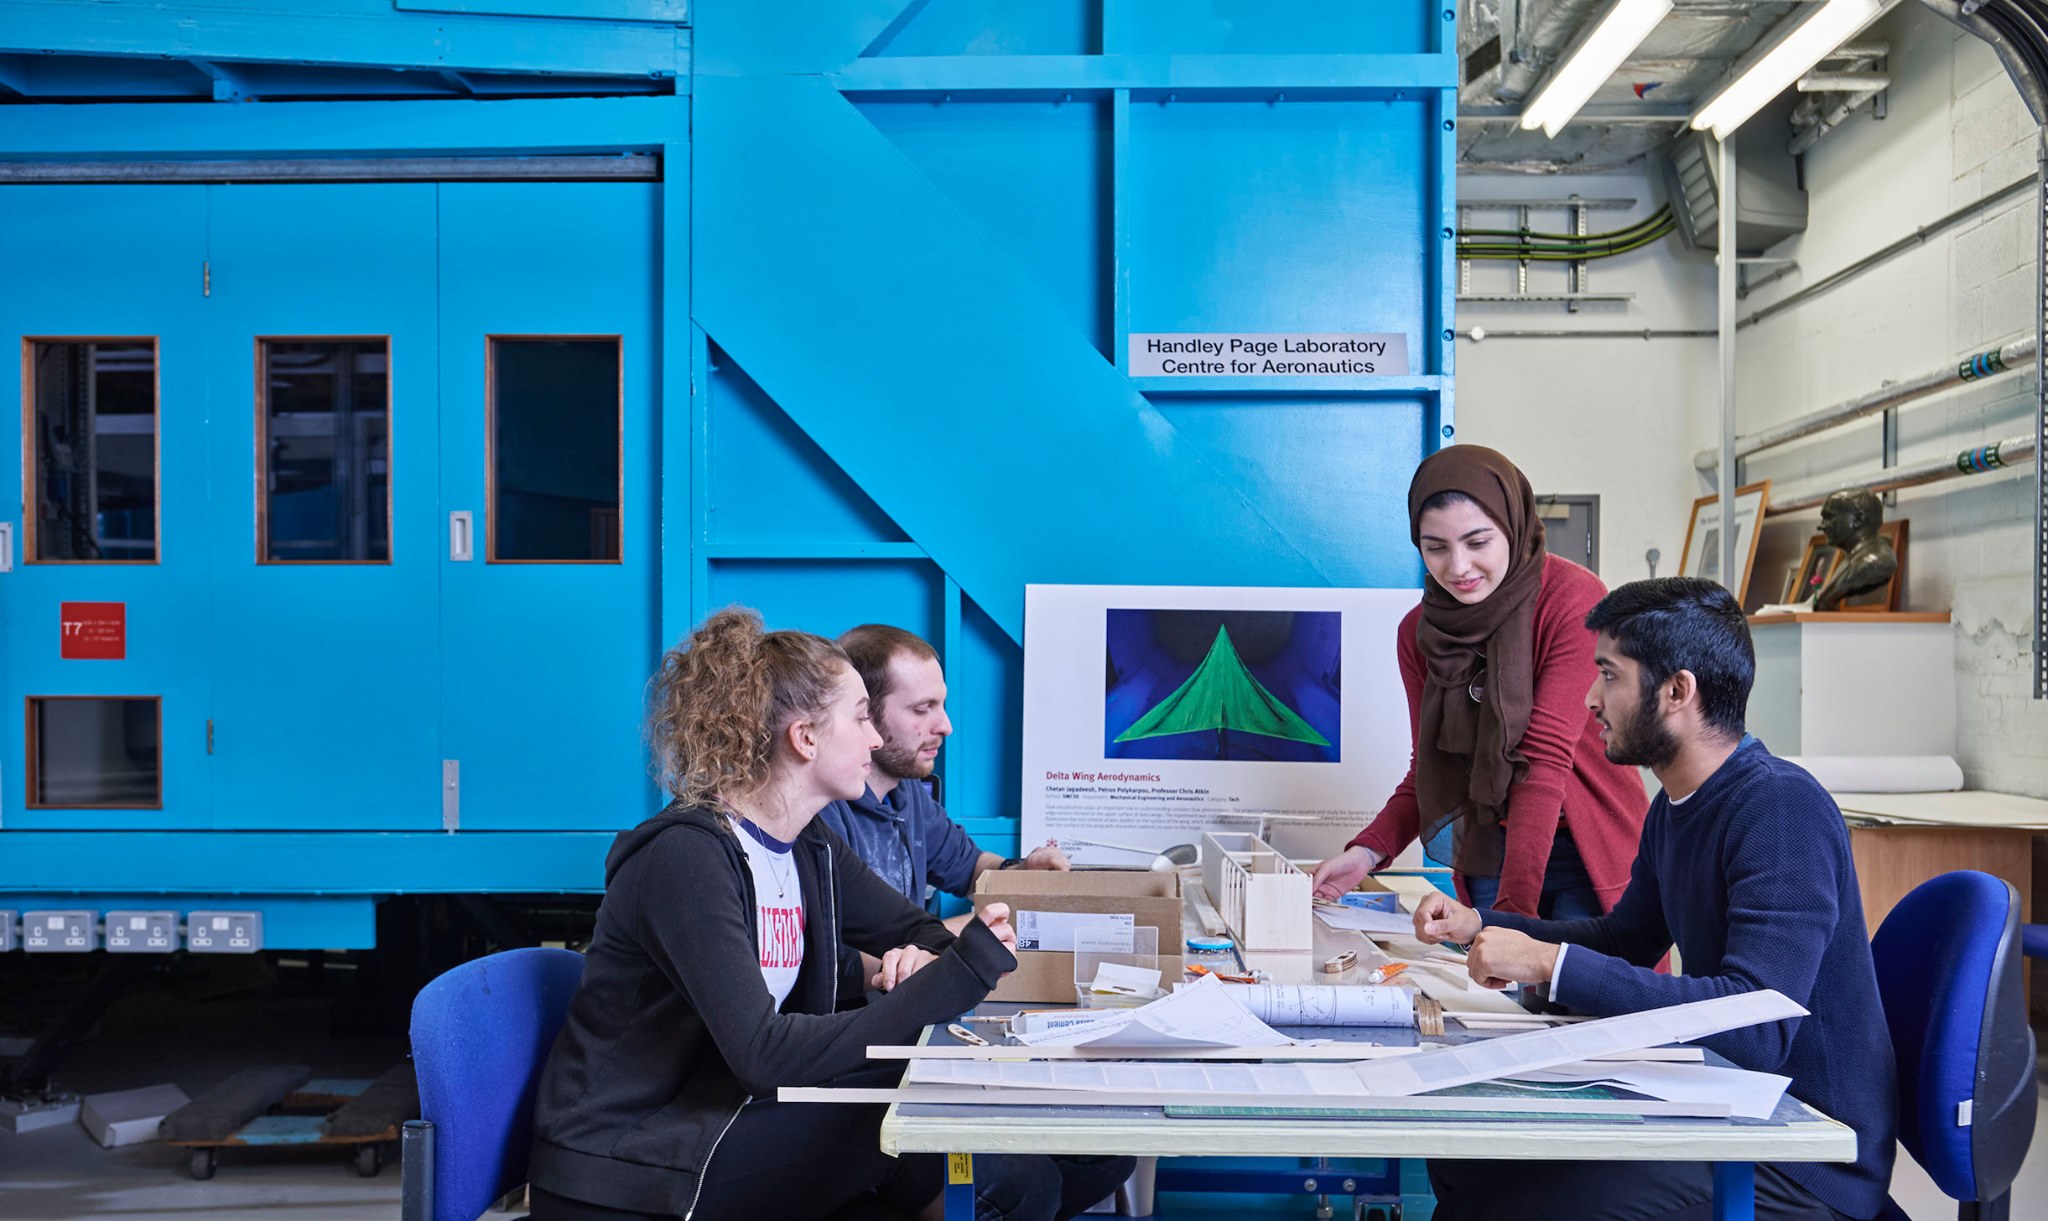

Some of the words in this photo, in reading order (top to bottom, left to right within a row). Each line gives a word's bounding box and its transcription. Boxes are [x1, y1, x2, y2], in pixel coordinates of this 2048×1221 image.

[1147, 338, 1224, 357] Handley
[1230, 338, 1278, 357] Page
[1284, 338, 1387, 357] Laboratory
[1162, 358, 1225, 374] Centre
[1230, 359, 1257, 374] for
[1261, 359, 1375, 374] Aeronautics
[63, 621, 82, 636] T7
[1046, 771, 1070, 780] Delta
[1072, 771, 1095, 783] Wing
[1097, 772, 1161, 783] Aerodynamics
[1179, 787, 1194, 795] Chris
[1018, 939, 1032, 949] 48
